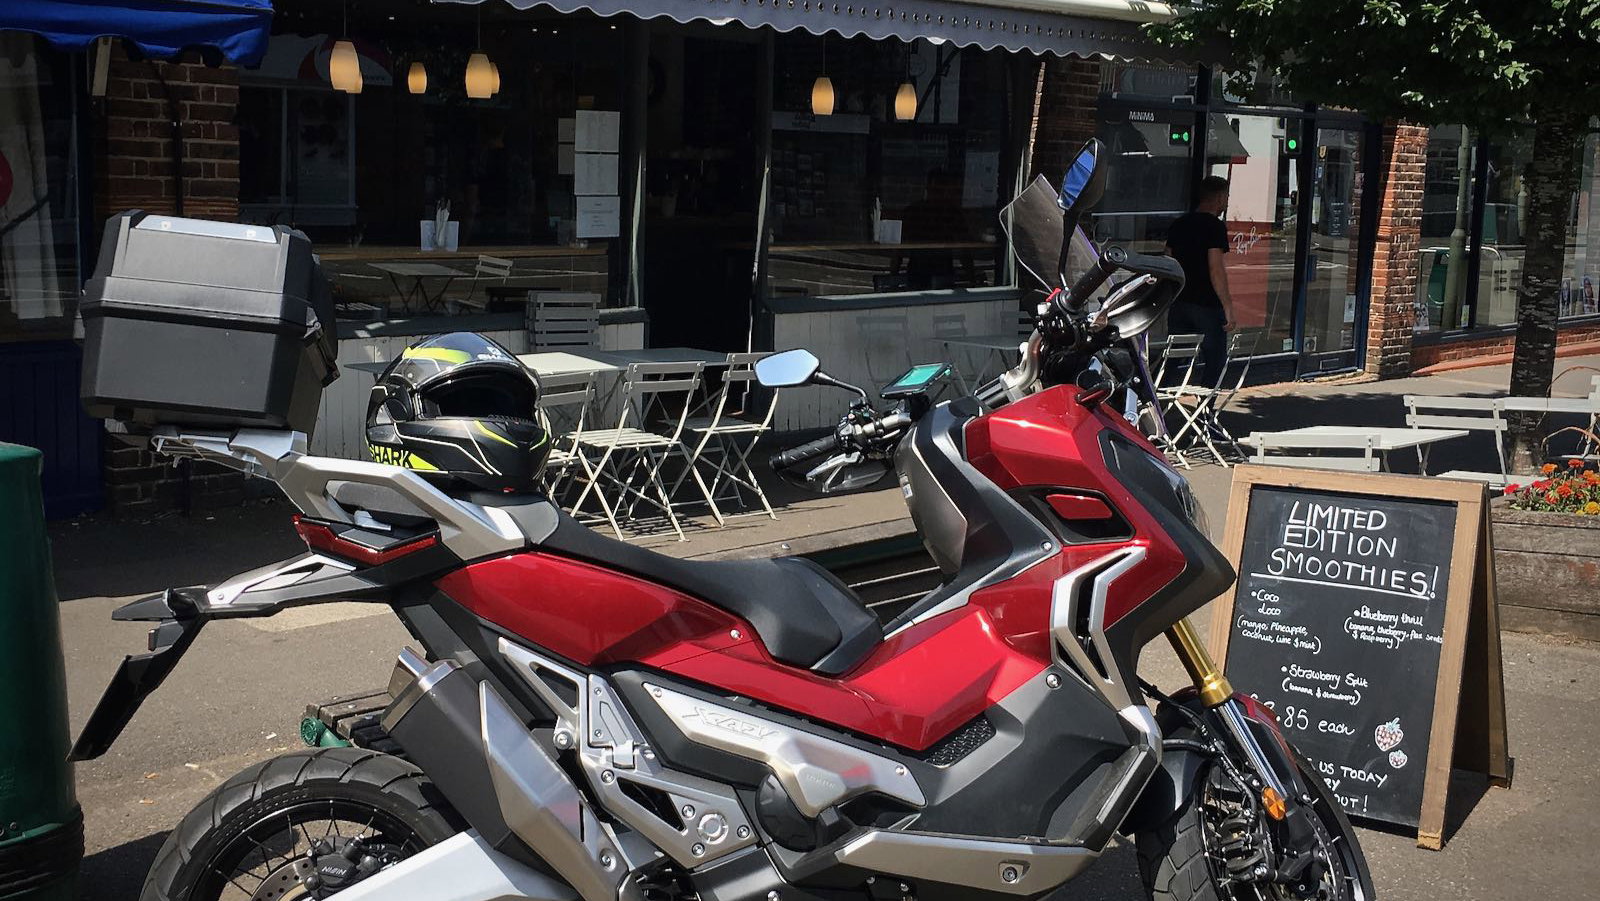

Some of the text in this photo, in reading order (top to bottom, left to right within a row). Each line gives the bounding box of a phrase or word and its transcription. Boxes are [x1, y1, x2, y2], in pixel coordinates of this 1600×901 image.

[1288, 500, 1387, 530] LIMITED
[1283, 524, 1397, 558] EDITION
[1266, 547, 1439, 598] SMOOTHIES!
[1361, 605, 1423, 629] Blueberry thrill
[1289, 663, 1368, 690] Strawberry Split
[1318, 719, 1355, 735] each
[1318, 761, 1335, 775] US
[1340, 765, 1388, 788] TODAY
